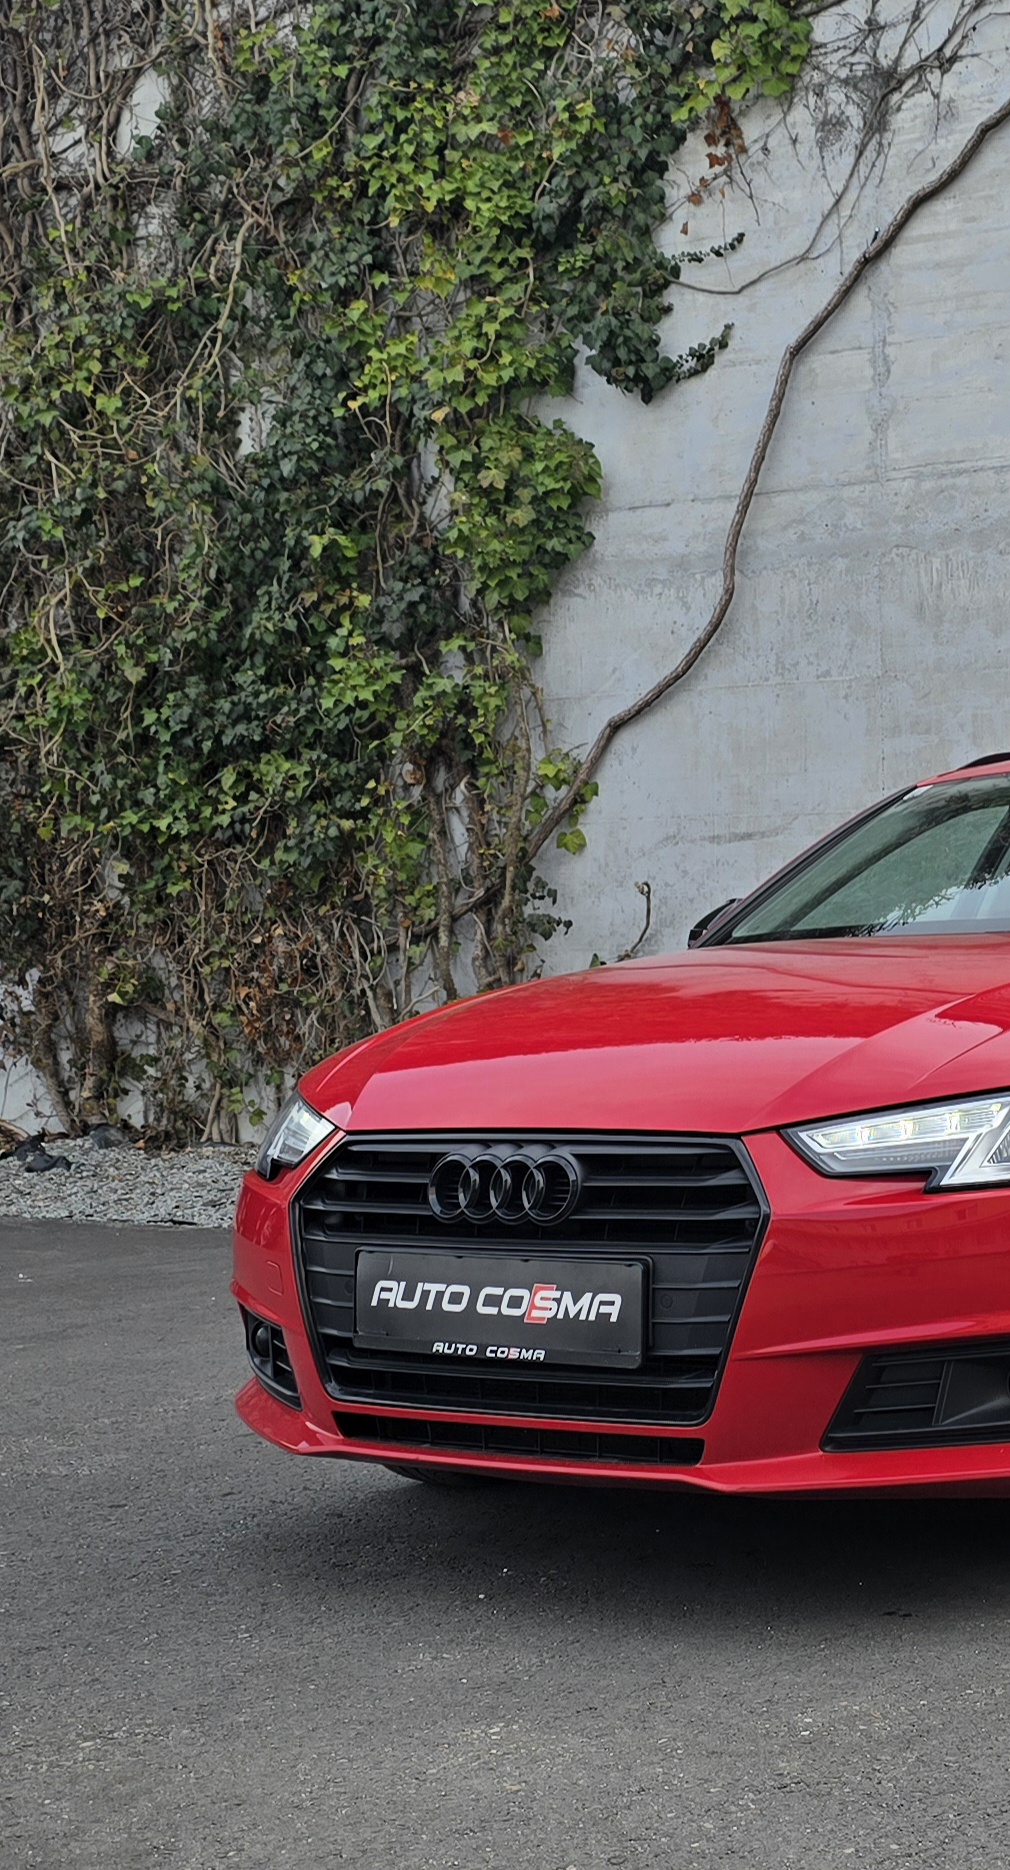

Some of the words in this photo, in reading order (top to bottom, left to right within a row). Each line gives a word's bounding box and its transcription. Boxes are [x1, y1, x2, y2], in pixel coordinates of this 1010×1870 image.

[370, 1280, 470, 1312] AUTO
[476, 1285, 622, 1323] COSMA
[432, 1341, 477, 1356] AUTO
[485, 1346, 546, 1361] COSMA
